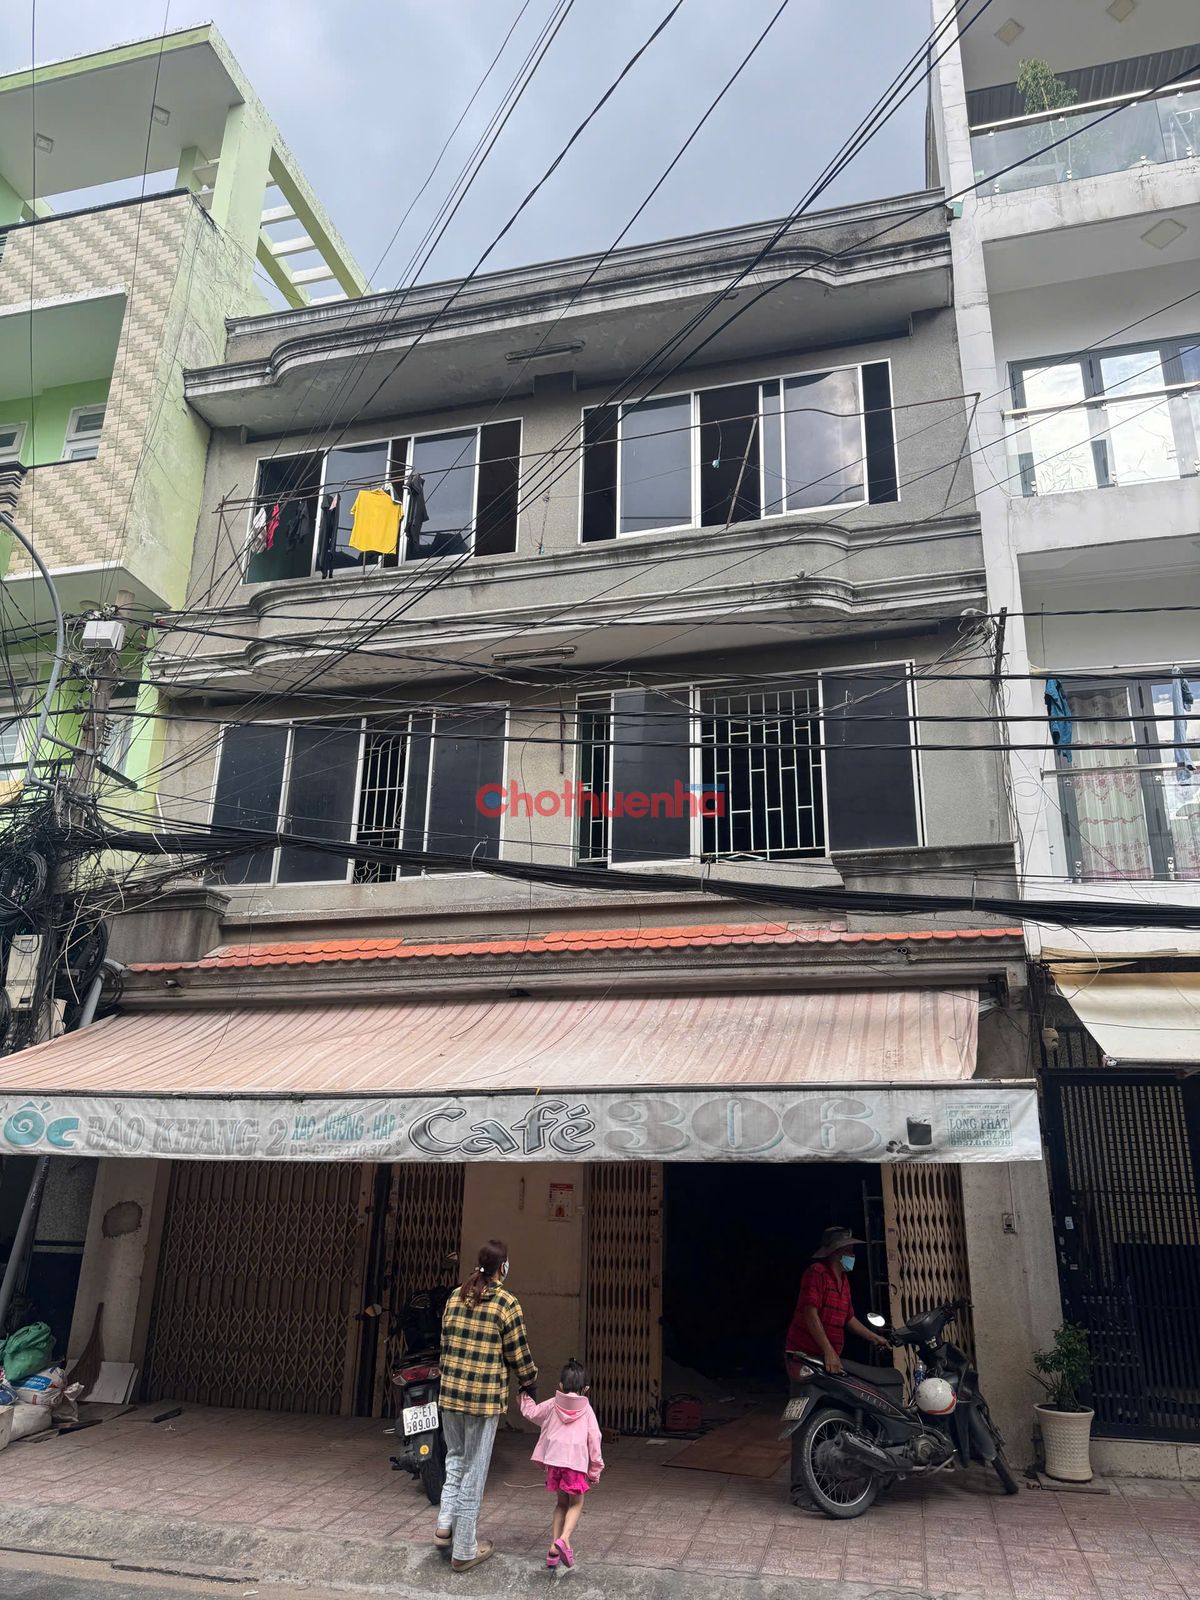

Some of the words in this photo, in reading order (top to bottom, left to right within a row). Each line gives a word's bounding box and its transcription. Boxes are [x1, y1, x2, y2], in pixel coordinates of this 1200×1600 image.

[152, 1116, 259, 1156] KHANG
[264, 1116, 289, 1156] 2
[408, 1100, 596, 1155] Café
[949, 1118, 977, 1130] LONG
[980, 1115, 1009, 1130] PHÁT
[406, 1416, 437, 1433] 589.00
